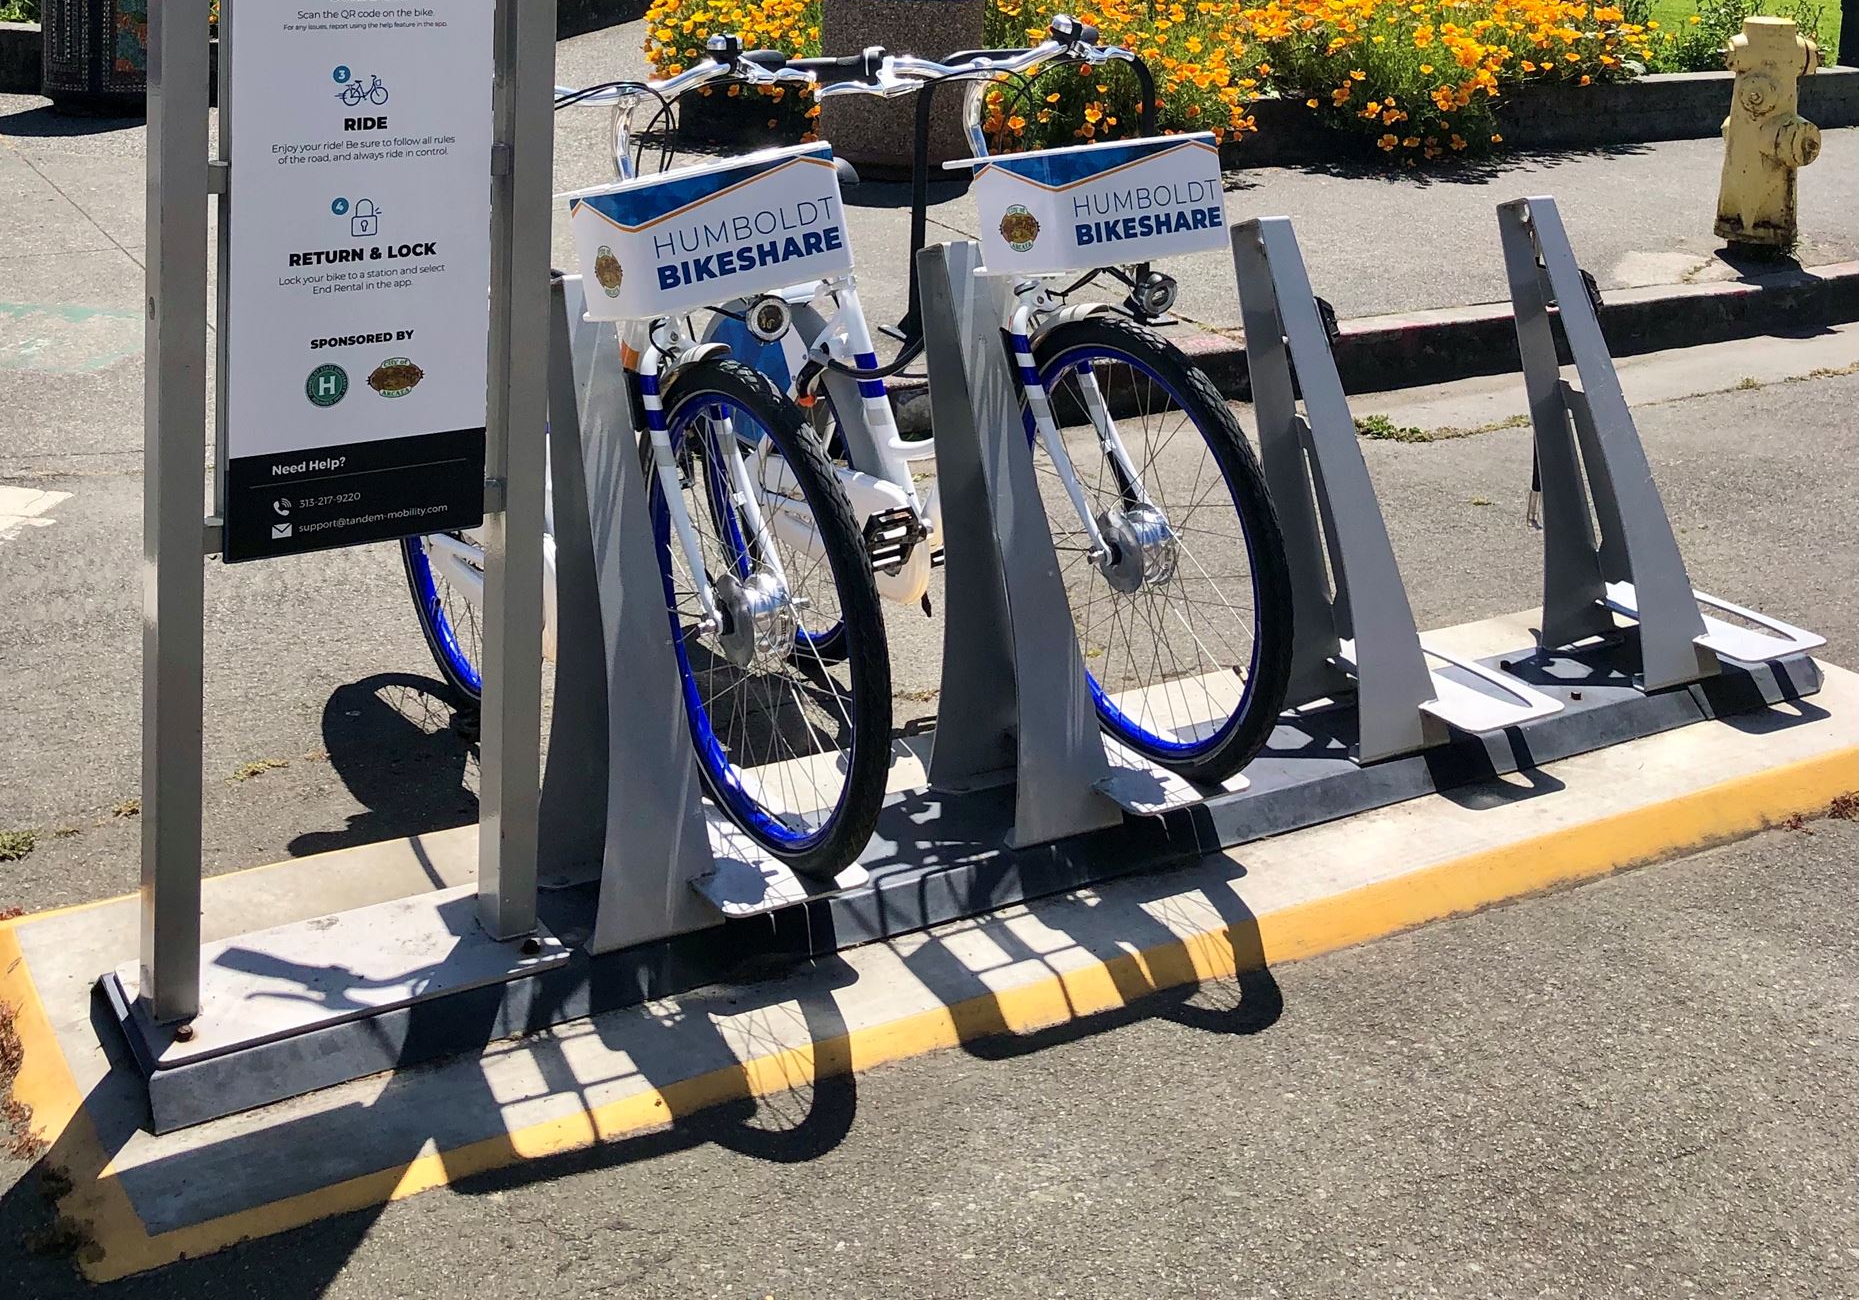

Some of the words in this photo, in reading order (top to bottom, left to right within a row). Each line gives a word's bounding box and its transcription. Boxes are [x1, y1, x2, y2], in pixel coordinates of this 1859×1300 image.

[297, 10, 321, 19] Scan
[323, 10, 339, 19] the
[340, 9, 356, 19] QR
[357, 9, 380, 18] code
[397, 9, 412, 17] the
[344, 116, 388, 131] RIDE
[272, 144, 298, 154] Enjoy
[300, 143, 321, 153] your
[323, 141, 344, 150] ride!
[346, 140, 359, 149] Be
[360, 140, 380, 148] sure
[393, 137, 421, 146] follow
[422, 136, 432, 145] all
[433, 135, 456, 144] rules
[278, 155, 288, 165] of
[290, 155, 305, 164] the
[307, 153, 331, 163] road,
[333, 152, 351, 161] and
[353, 151, 384, 160] always
[385, 149, 403, 158] ride
[415, 147, 448, 156] control.
[1073, 179, 1217, 217] HUMBOLDT
[653, 196, 833, 259] HUMBOLDT
[1075, 206, 1223, 246] BIKESHARE
[288, 248, 364, 267] RETURN
[369, 247, 382, 260] &
[387, 241, 437, 259] LOCK
[656, 226, 843, 291] BIKESHARE
[278, 275, 301, 286] Lock
[302, 275, 324, 286] your
[326, 272, 346, 282] bike
[348, 271, 358, 280] to
[367, 268, 398, 278] station
[400, 264, 418, 275] and
[419, 263, 445, 274] select
[312, 284, 332, 294] End
[334, 282, 364, 292] Rental
[366, 281, 374, 290] in
[376, 280, 392, 289] the
[310, 331, 393, 350] SPONSORED
[396, 330, 415, 341] BY
[318, 375, 336, 396] H
[272, 462, 306, 476] Need
[309, 456, 346, 471] Help?
[299, 492, 361, 509] 313-217-9220
[299, 504, 448, 532] support@tandem-mobility.com
